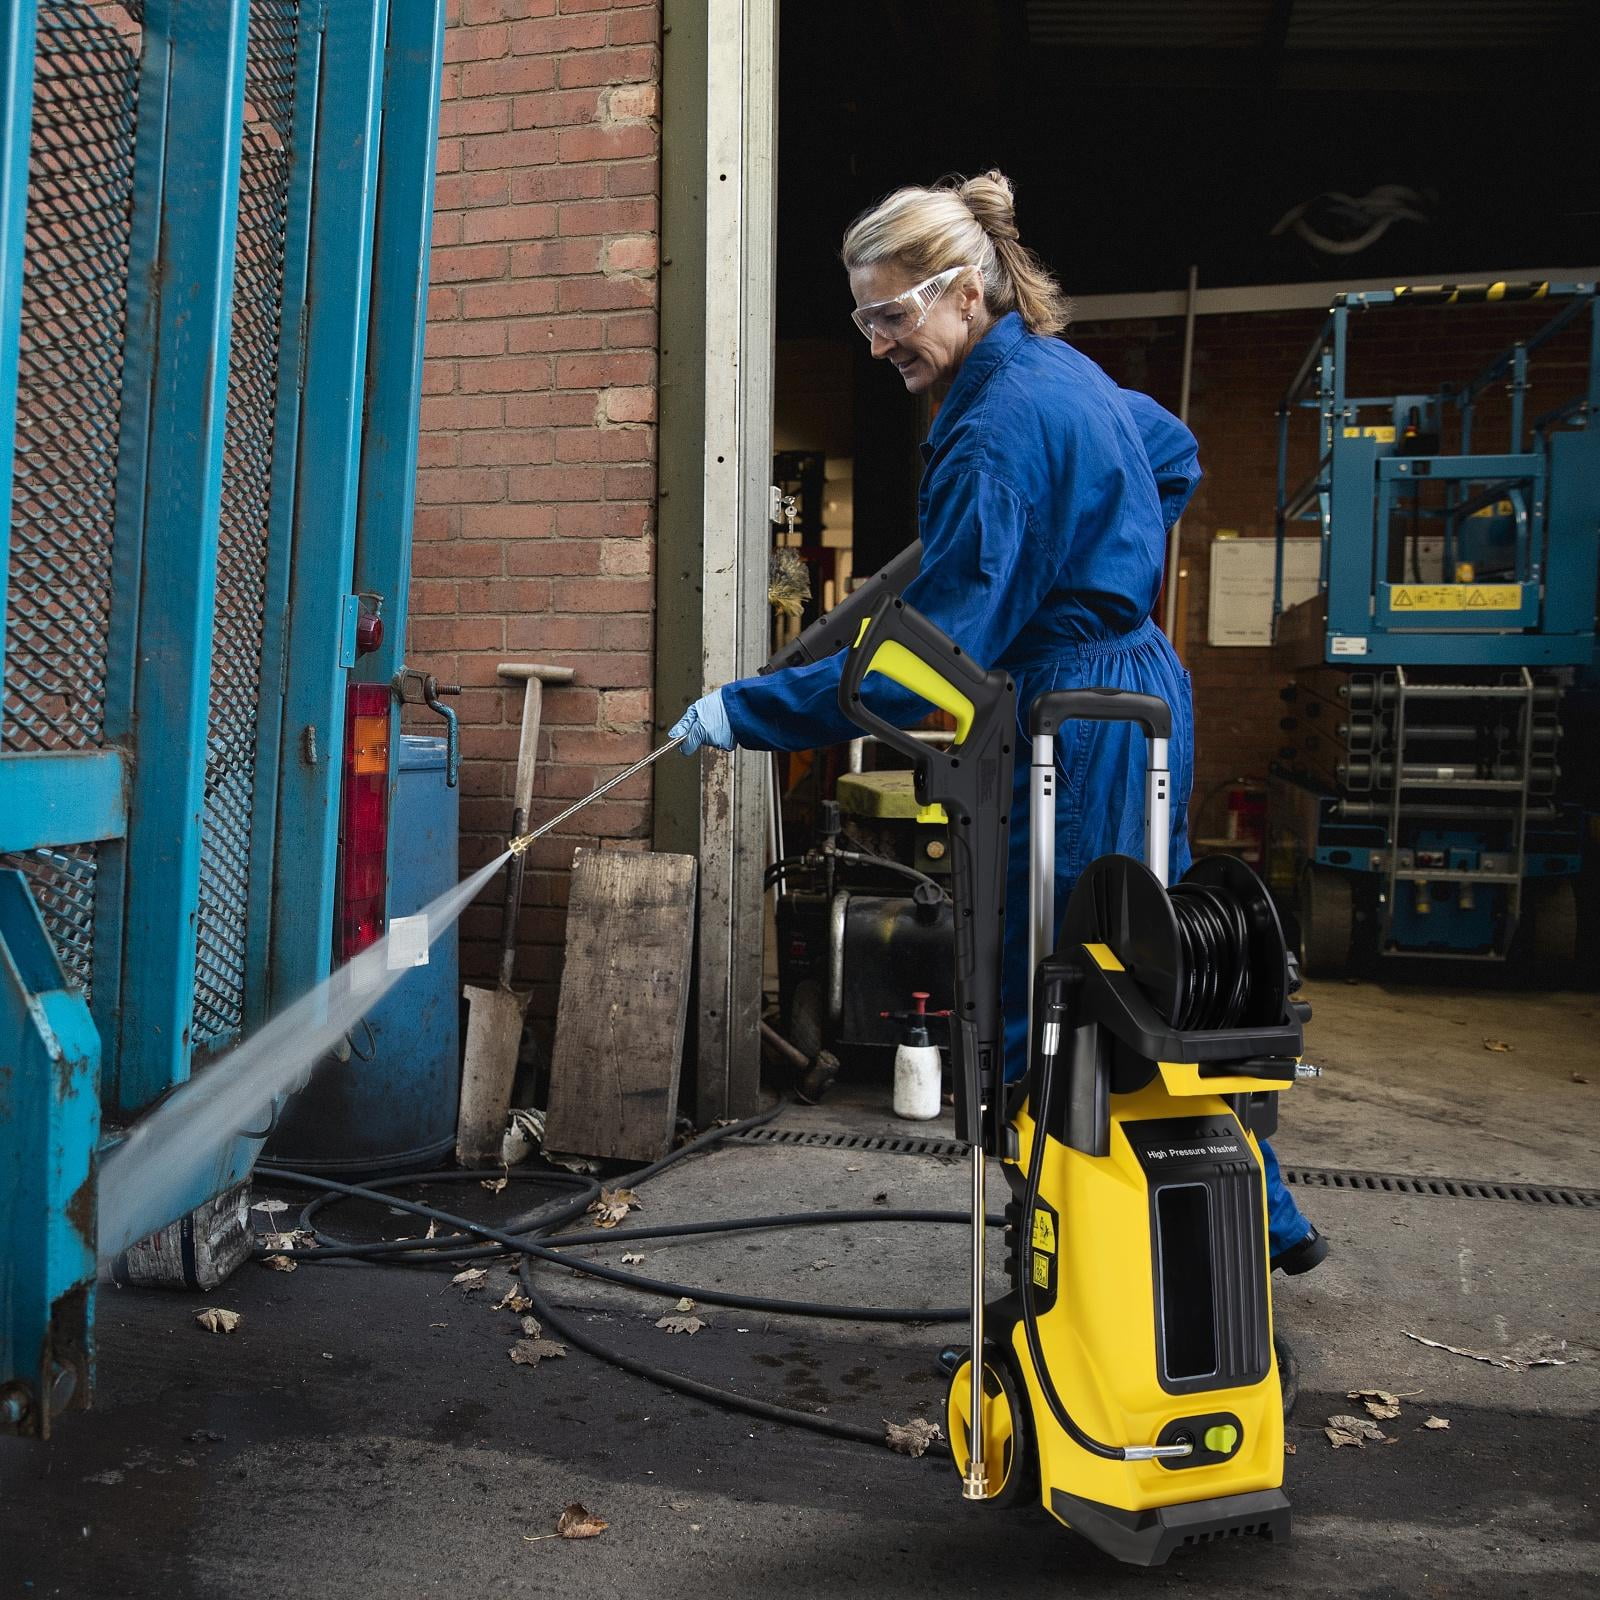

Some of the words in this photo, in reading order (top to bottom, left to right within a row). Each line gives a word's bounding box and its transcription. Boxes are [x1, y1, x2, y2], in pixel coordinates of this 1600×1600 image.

[1147, 1150, 1168, 1160] High
[1169, 1147, 1206, 1157] Pressure
[1207, 1144, 1238, 1154] Washer
